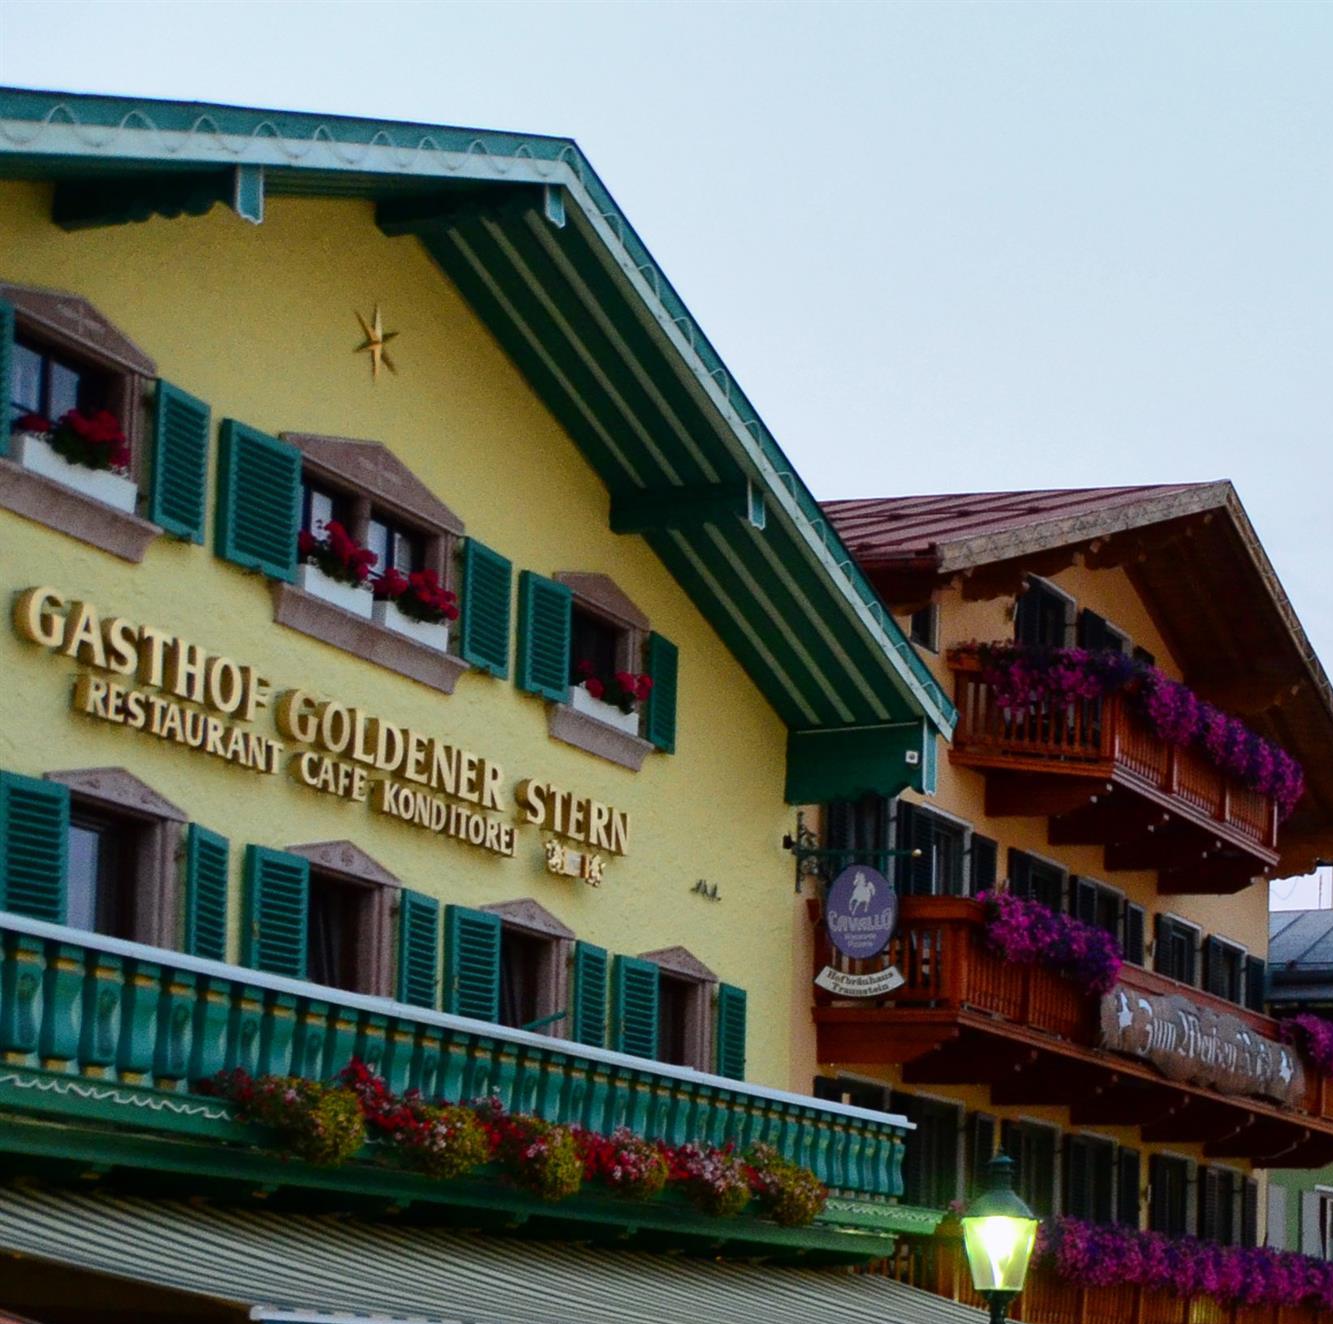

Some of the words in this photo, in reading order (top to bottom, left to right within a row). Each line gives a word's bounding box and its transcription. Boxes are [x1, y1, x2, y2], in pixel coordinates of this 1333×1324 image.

[24, 585, 273, 723] GASTHOF
[286, 688, 505, 812] GOLDENER
[524, 777, 631, 856] STERN
[84, 675, 284, 775] RESTAURANT
[300, 752, 369, 802] CAFE
[381, 779, 520, 858] KONDITOREI
[832, 981, 889, 995] Traunstein
